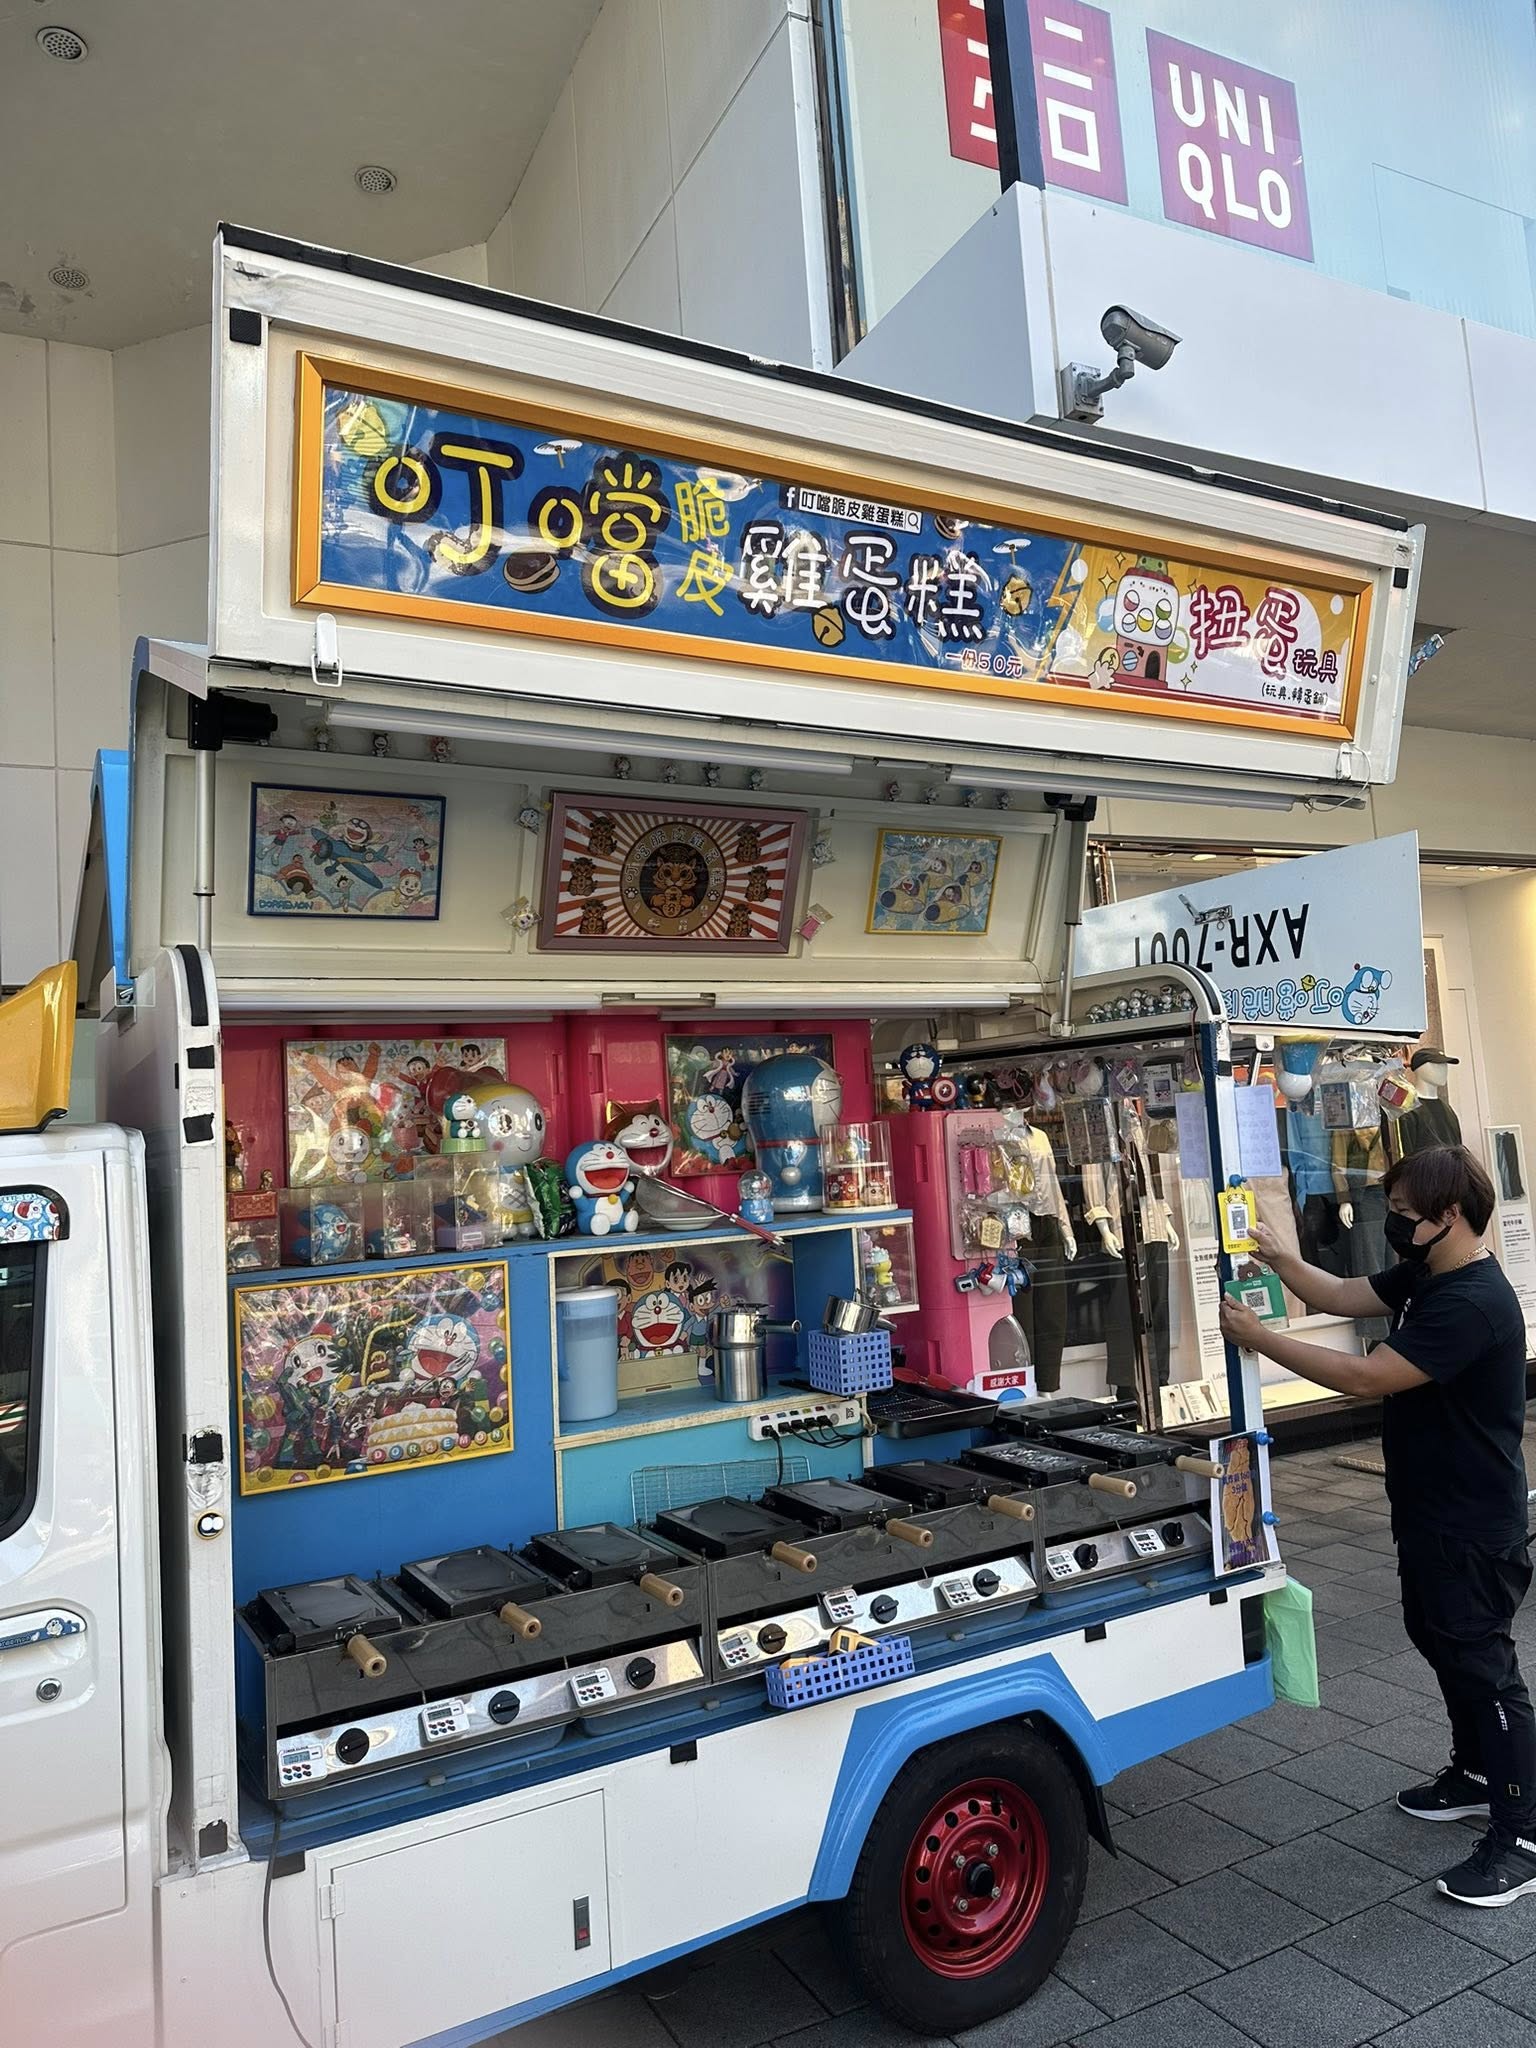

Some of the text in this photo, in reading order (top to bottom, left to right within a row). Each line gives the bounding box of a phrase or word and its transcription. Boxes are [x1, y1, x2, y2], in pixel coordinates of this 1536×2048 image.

[1167, 62, 1276, 155] UNI
[1178, 142, 1293, 229] QLO
[675, 476, 735, 617] 脆皮
[800, 488, 906, 528] 叮噹脆皮雞蛋糕
[740, 522, 991, 642] 雞蛋糕
[945, 649, 1023, 678] 一份50元
[1189, 584, 1301, 680] 扭蛋
[1293, 648, 1338, 684] 玩具
[372, 1428, 503, 1462] DORAEMON
